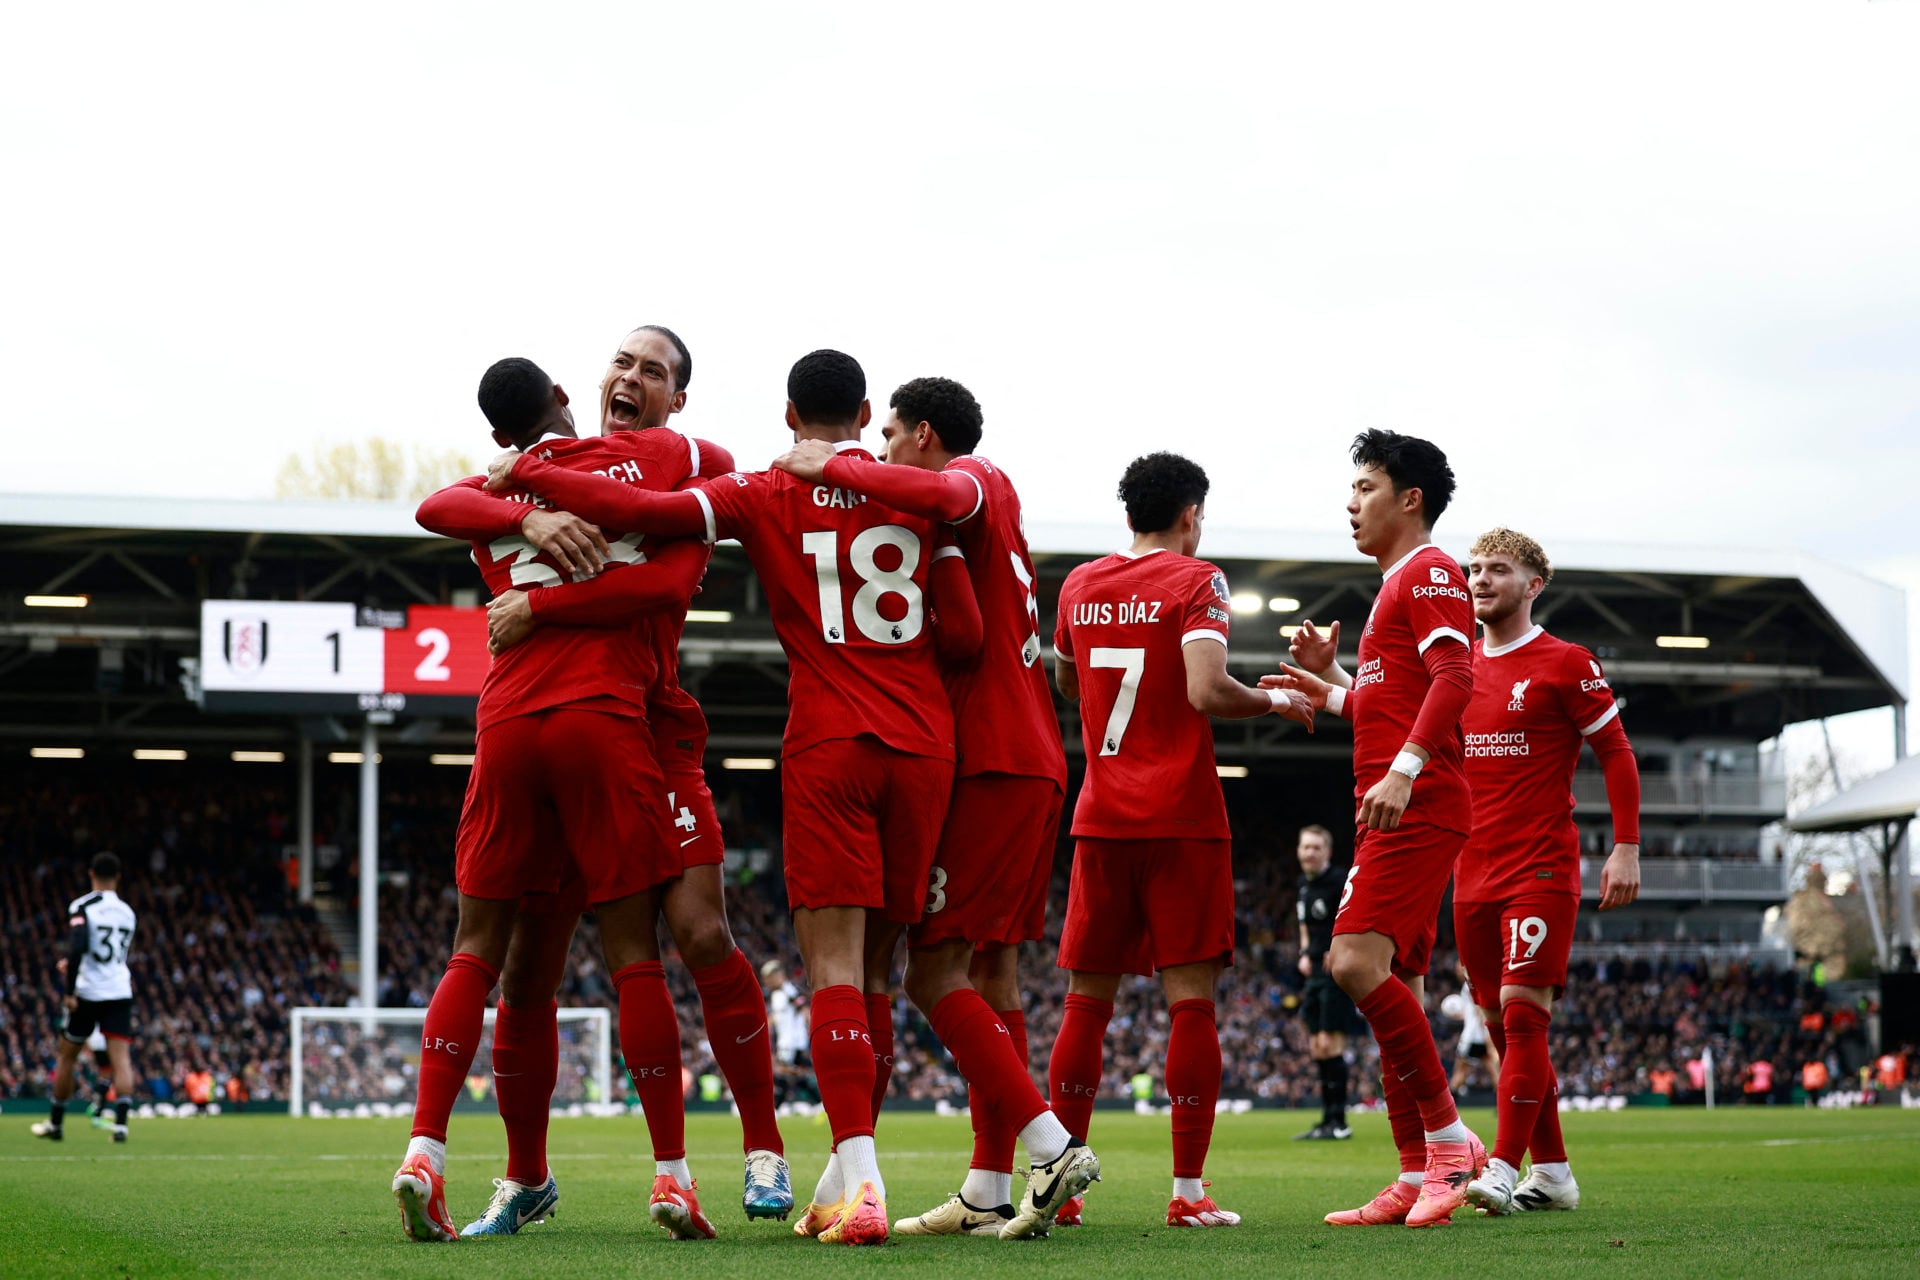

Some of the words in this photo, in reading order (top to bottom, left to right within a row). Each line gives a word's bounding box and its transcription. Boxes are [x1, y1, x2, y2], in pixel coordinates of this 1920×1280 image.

[802, 524, 924, 645] 18
[1412, 585, 1468, 602] Expedia
[1073, 603, 1113, 625] LUIS
[1118, 594, 1162, 625] DÍAZ
[324, 631, 340, 674] 1
[414, 627, 451, 681] 2
[1089, 647, 1146, 757] 7
[1465, 731, 1525, 745] standard
[1465, 744, 1529, 757] chartered
[1509, 916, 1547, 959] 19
[424, 1037, 459, 1054] LFC
[830, 1029, 871, 1045] LFC
[628, 1066, 666, 1079] LFC
[1060, 1082, 1095, 1097] LFC
